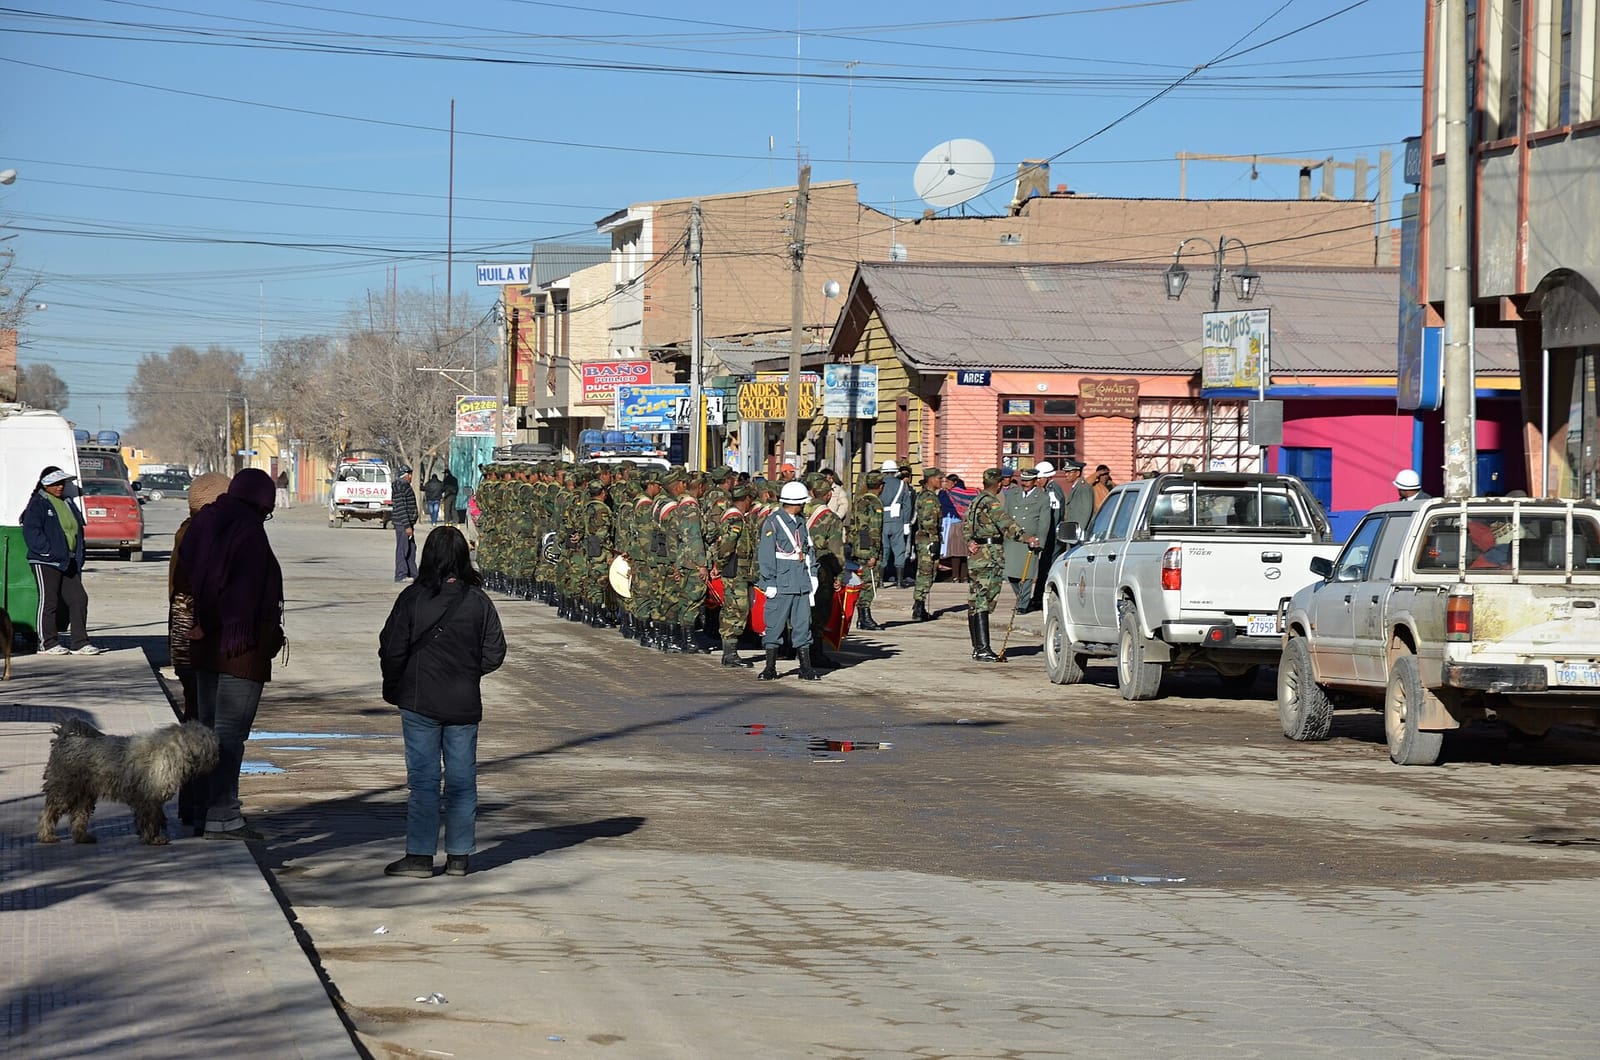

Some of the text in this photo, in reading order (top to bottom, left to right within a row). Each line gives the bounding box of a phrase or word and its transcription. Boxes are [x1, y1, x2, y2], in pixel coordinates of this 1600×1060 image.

[479, 267, 514, 281] HUILA
[586, 362, 648, 376] BAÑO
[963, 373, 985, 384] ARCE
[586, 384, 621, 392] DUCH
[742, 383, 779, 397] ANDES
[784, 383, 812, 397] SLT
[740, 397, 814, 410] EXPEDITNS
[743, 409, 811, 418] TOUR OPEOR
[346, 487, 388, 496] NISSAN
[1250, 622, 1275, 633] 2795P
[1558, 670, 1576, 682] 789
